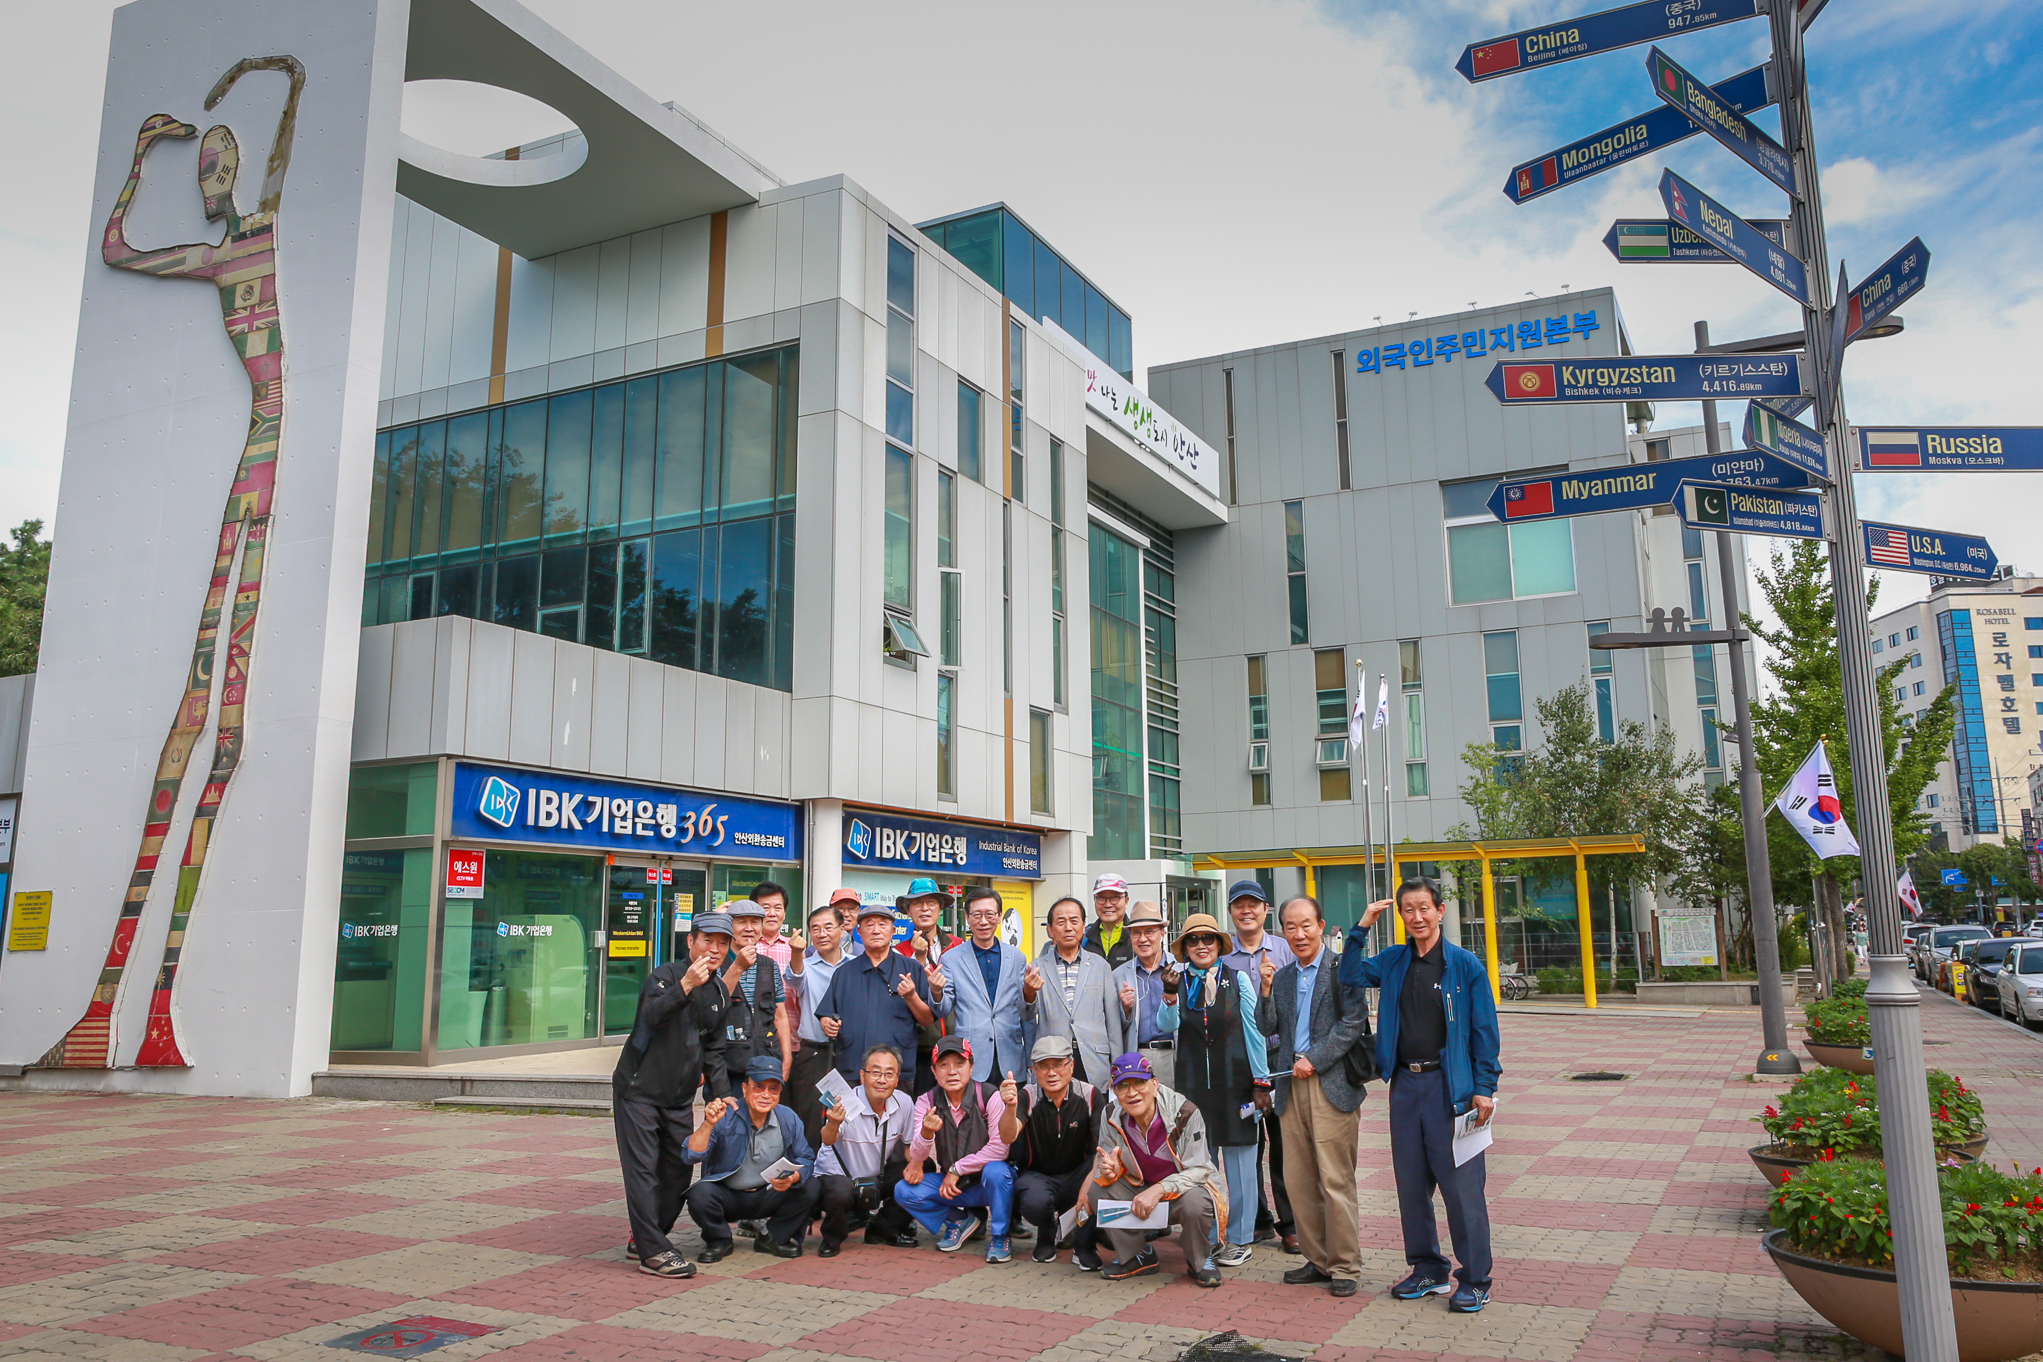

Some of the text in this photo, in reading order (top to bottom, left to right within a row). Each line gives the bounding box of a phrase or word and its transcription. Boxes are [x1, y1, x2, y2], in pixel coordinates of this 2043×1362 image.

[1665, 0, 1702, 16] (중국)
[1668, 12, 1717, 29] 947.85km
[1525, 28, 1580, 54] China
[1528, 43, 1588, 62] Beijing (베이징)
[1687, 80, 1748, 143] Bangladesh
[1562, 124, 1648, 170] Mongolia
[1564, 156, 1606, 179] Ulaanbaatar
[1700, 200, 1734, 239] Nepal
[1902, 253, 1916, 275] (중국)
[1862, 274, 1892, 308] China
[1357, 310, 1600, 374] 외국인주민지원본부
[1562, 365, 1676, 387] Kyrgyzstan
[1699, 362, 1788, 378] (키르기스스탄)
[1565, 387, 1600, 396] Bishkek
[1702, 380, 1762, 392] 4,416.89km
[1777, 420, 1801, 447] Nigeria
[1926, 434, 2002, 454] Russia
[1173, 430, 1199, 470] 안산
[1928, 456, 2004, 465] Moskva (모스크바)
[1712, 458, 1764, 476] (미얀마)
[1562, 472, 1656, 500] Myanmar
[1731, 493, 1818, 518] Pakistan (파키스탄)
[1910, 535, 1988, 560] U.S.A. (미국)
[1976, 608, 2016, 616] ROSABELL
[680, 803, 728, 846] 365
[734, 831, 786, 848] 안산외환송금센터
[979, 841, 1036, 854] Industrial Bank of Korea
[454, 861, 478, 874] 에스원
[864, 892, 880, 900] SMART
